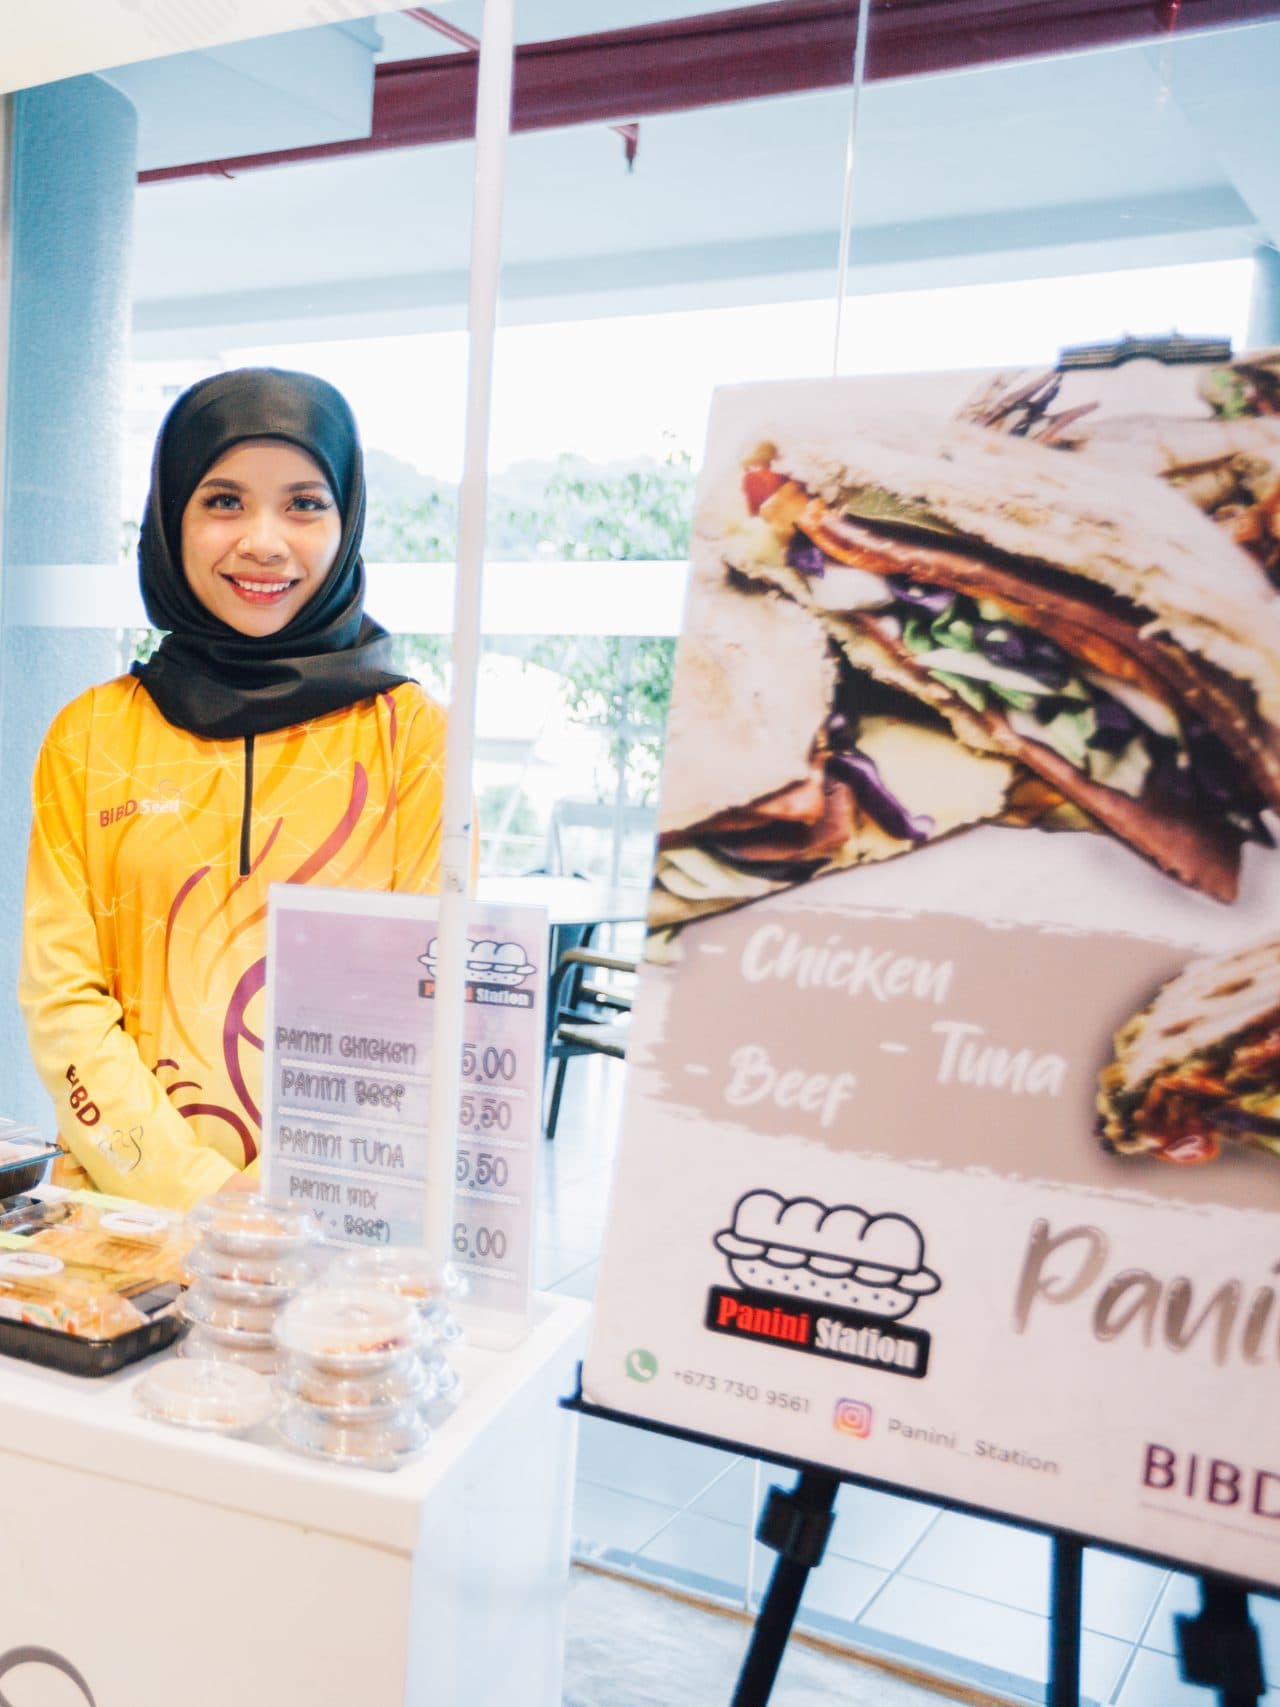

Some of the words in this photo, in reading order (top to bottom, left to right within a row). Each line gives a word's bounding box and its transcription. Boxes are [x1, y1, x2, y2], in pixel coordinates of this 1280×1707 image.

[740, 922, 955, 1004] Chicken
[724, 1044, 858, 1128] Beef
[931, 1020, 1068, 1098] Tuna
[452, 1222, 507, 1260] 6.00
[1012, 1216, 1280, 1368] Pani
[716, 1295, 811, 1345] Panini
[814, 1316, 919, 1370] Station
[673, 1368, 718, 1391] +673
[723, 1379, 758, 1401] 730
[765, 1390, 810, 1414] 9561
